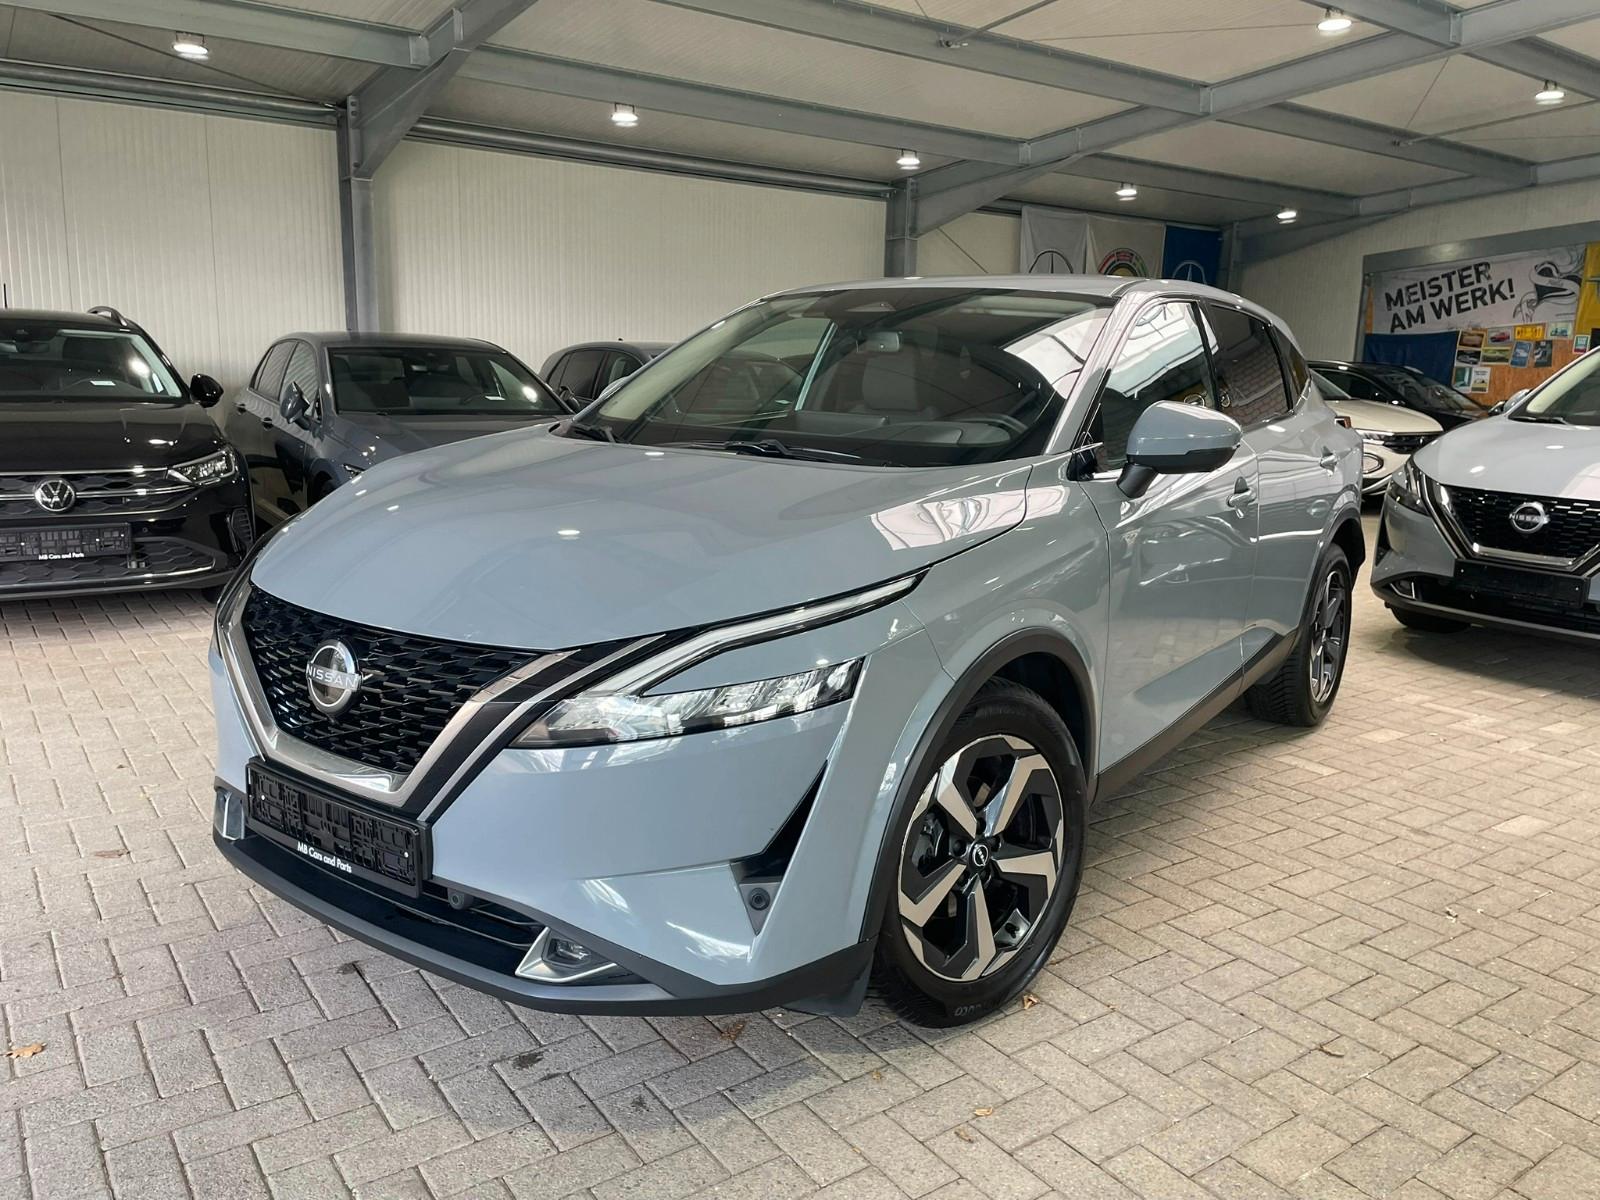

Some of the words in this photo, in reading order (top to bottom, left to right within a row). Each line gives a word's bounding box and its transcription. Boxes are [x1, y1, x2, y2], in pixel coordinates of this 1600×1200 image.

[1385, 262, 1491, 311] MEISTER
[1390, 305, 1426, 333] AM
[1430, 278, 1516, 319] WERK!
[306, 663, 358, 690] NISSAN
[297, 841, 308, 854] MB
[308, 846, 323, 861] Cars
[323, 855, 336, 867] and
[336, 857, 352, 873] Parts
